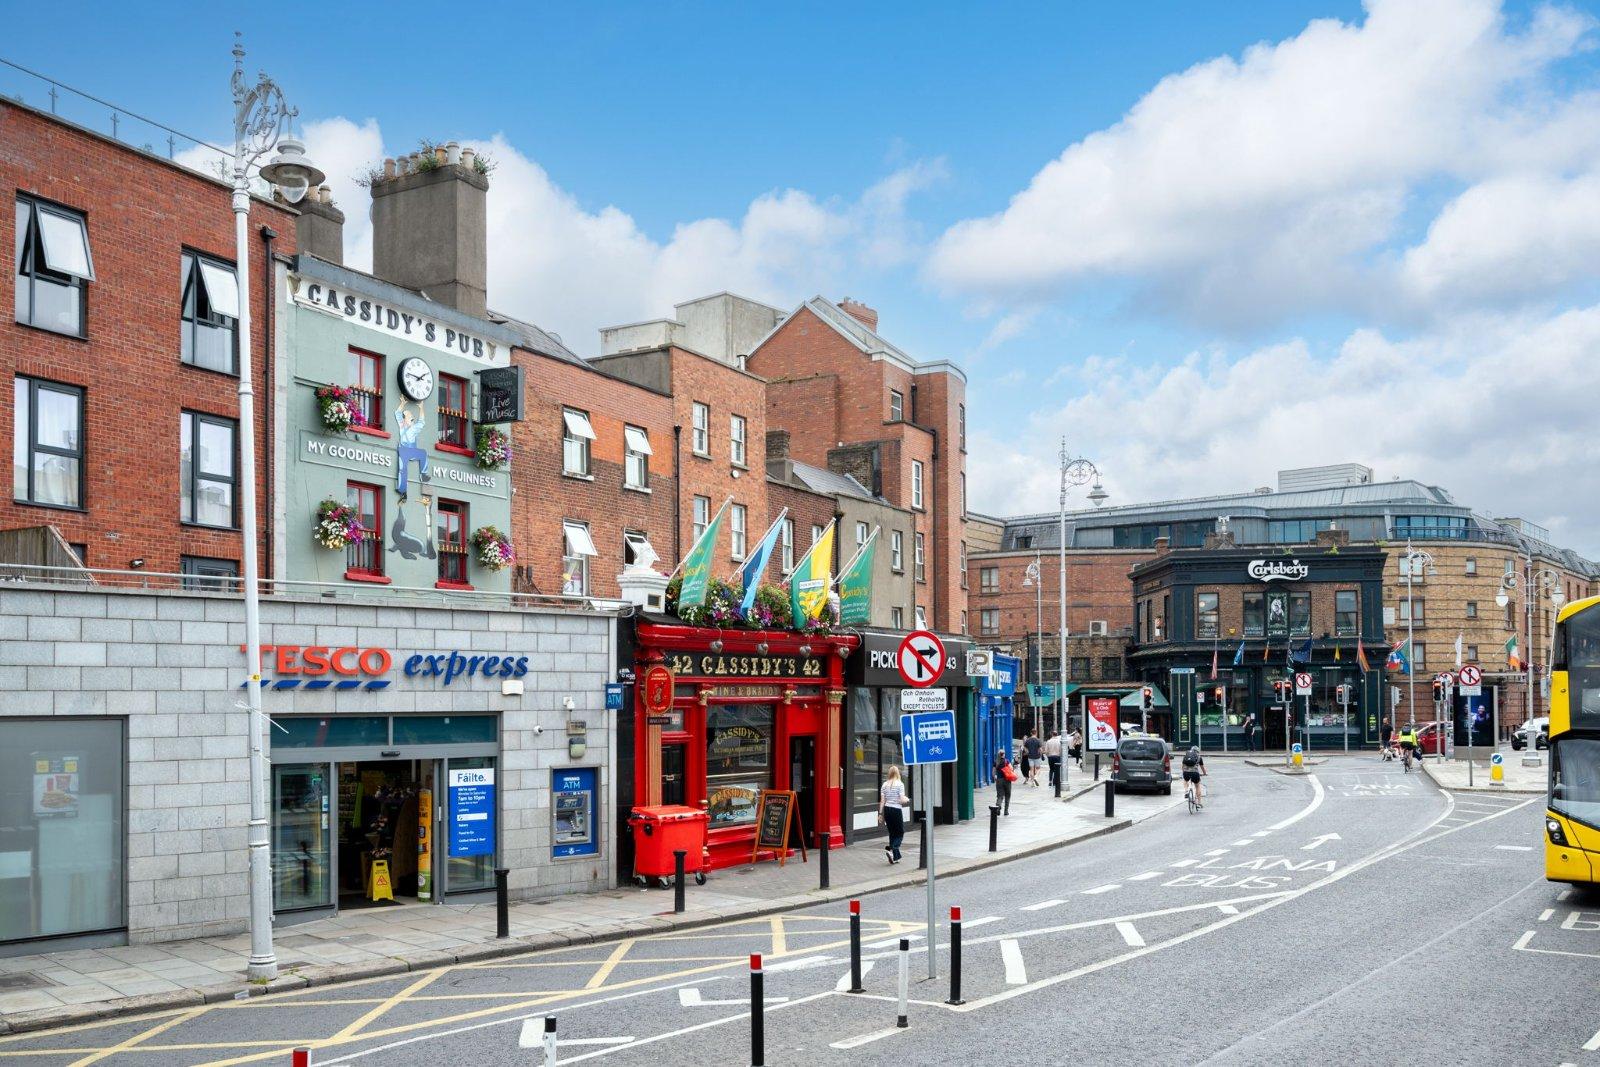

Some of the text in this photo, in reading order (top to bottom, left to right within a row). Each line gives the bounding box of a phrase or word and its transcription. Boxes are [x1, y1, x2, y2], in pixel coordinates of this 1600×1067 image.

[308, 284, 484, 358] CASSIDY'S PUB
[491, 397, 510, 409] Live
[486, 408, 516, 420] Music
[308, 440, 392, 468] MY GOODNESS
[433, 465, 497, 489] MY GUINNESS
[1247, 559, 1309, 582] Carlsberg
[240, 645, 529, 687] TESCO express
[672, 655, 821, 676] 42 CASSIDY'S 42
[945, 657, 957, 669] 43
[607, 694, 621, 705] ATM
[716, 727, 760, 745] CASSIDY'S
[562, 781, 580, 790] ATM
[1160, 873, 1293, 889] BUS
